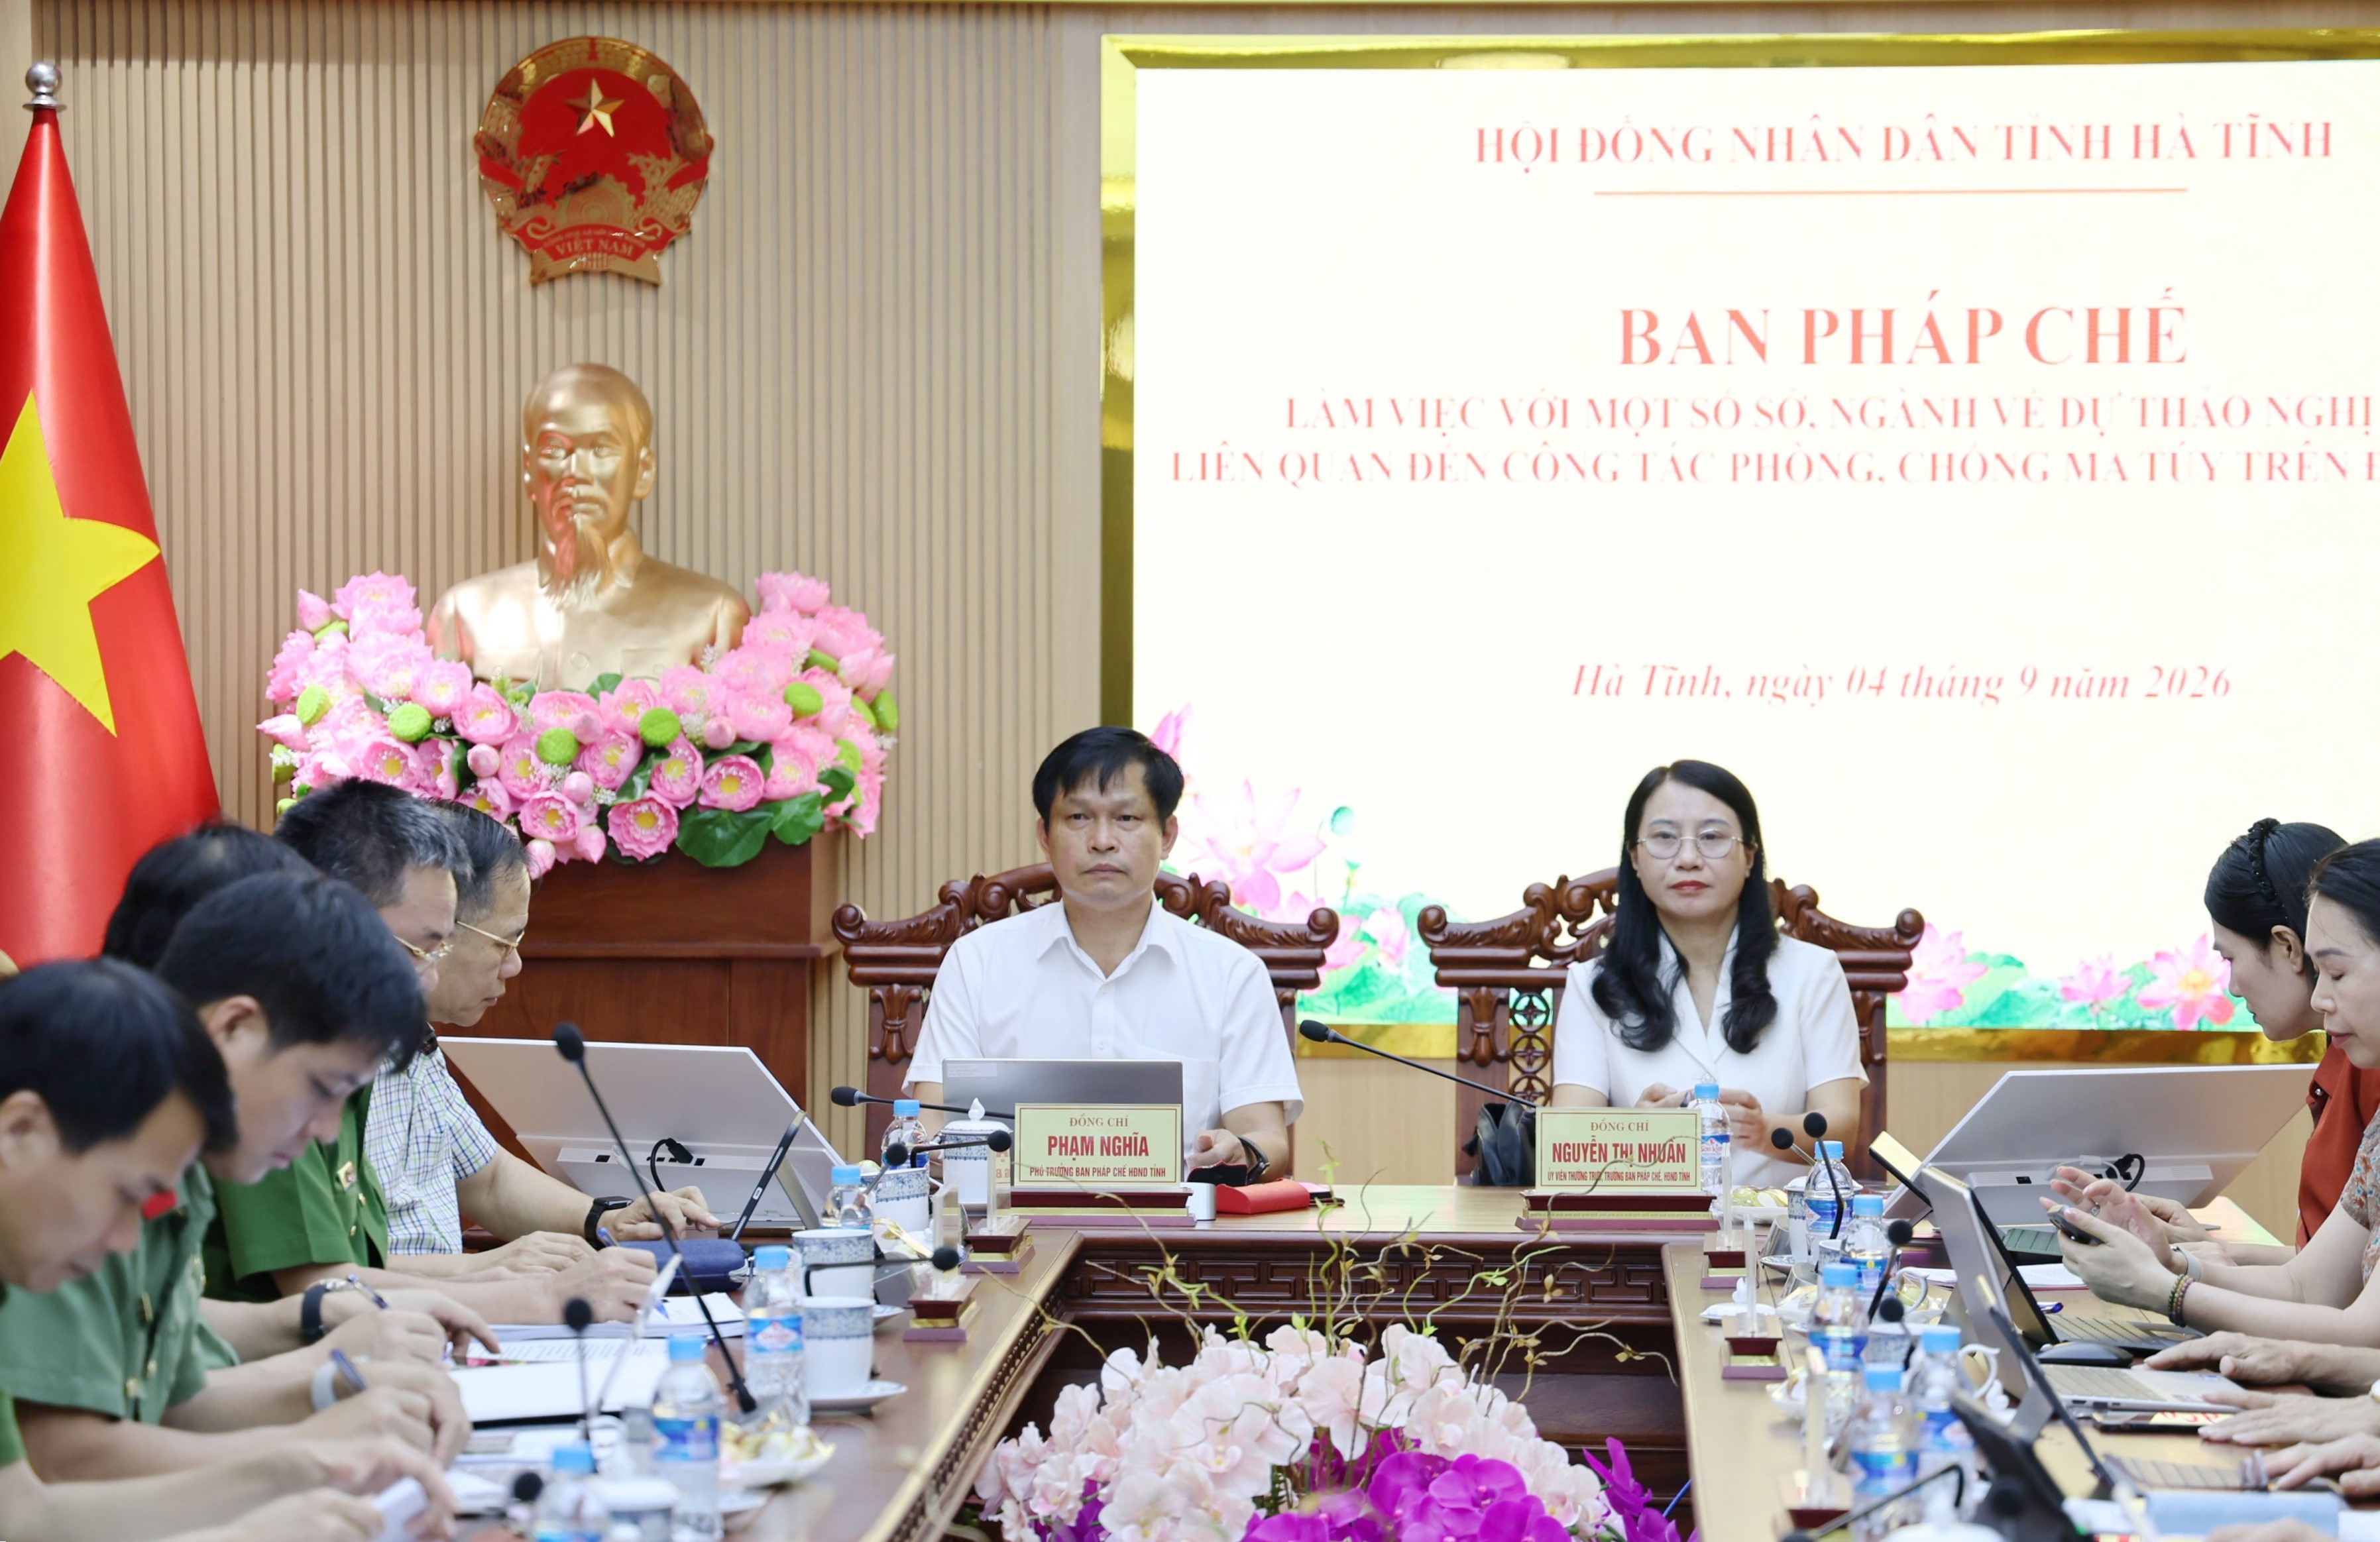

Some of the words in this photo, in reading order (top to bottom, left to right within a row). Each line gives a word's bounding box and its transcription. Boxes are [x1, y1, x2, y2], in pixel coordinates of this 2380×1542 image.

[1475, 121, 1559, 174] HỘI
[1577, 115, 1713, 164] ĐỒNG
[1730, 113, 1863, 164] NHÂN
[1881, 112, 1978, 163] DÂN
[2130, 111, 2199, 160] HÀ
[2211, 112, 2334, 159] TĨNH
[598, 238, 634, 257] NAM
[1618, 307, 1771, 366] BAN
[1800, 288, 2005, 366] PHÁP
[2023, 286, 2188, 366] CHẾ
[1285, 388, 1374, 429] LÀM
[1388, 395, 1485, 438] VIỆC
[1498, 387, 1569, 429] VỚI
[1585, 395, 1679, 438] MỘT
[1689, 388, 1742, 429] SỐ
[1829, 387, 1978, 429] NGÀNH
[2059, 392, 2122, 438] DỰ
[2265, 395, 2373, 437] NGHỊ
[1171, 439, 1264, 482] LIÊN
[1277, 451, 1393, 489] QUAN
[1408, 442, 1487, 482] ĐẾN
[1501, 440, 1619, 483] CÔNG
[1632, 441, 1716, 482] TÁC
[1897, 441, 2049, 483] CHỐNG
[2064, 451, 2129, 482] MA
[2139, 440, 2225, 482] TÚY
[2235, 439, 2349, 482] TRÊN
[1571, 663, 1624, 698] Hà
[1642, 663, 1732, 700] Tĩnh,
[1745, 664, 1834, 706] ngày
[1845, 665, 1888, 698] 04
[1899, 664, 2006, 706] tháng
[2018, 665, 2039, 698] 9
[2049, 667, 2130, 699] năm
[2143, 664, 2232, 699] 2026
[1069, 1113, 1104, 1127] ĐỒNG
[1107, 1115, 1129, 1127] CHÍ
[1590, 1118, 1624, 1132] ĐỒNG
[1628, 1119, 1649, 1132] CHÍ
[1048, 1135, 1095, 1161] PHẠM
[1100, 1132, 1149, 1157] NGHĨA
[1552, 1134, 1608, 1163] NGUYỄN
[1612, 1142, 1633, 1168] THỊ
[1029, 1164, 1044, 1177] PHÓ
[1046, 1162, 1074, 1177] TRƯỞNG
[1075, 1167, 1090, 1177] BAN
[1092, 1164, 1111, 1177] PHÁP
[1113, 1164, 1127, 1177] CHẾ
[1128, 1167, 1148, 1178] HĐND
[1149, 1164, 1166, 1178] TỈNH
[1624, 1171, 1636, 1182] BAN
[1636, 1169, 1650, 1182] PHÁP
[1678, 1168, 1691, 1182] TỈNH
